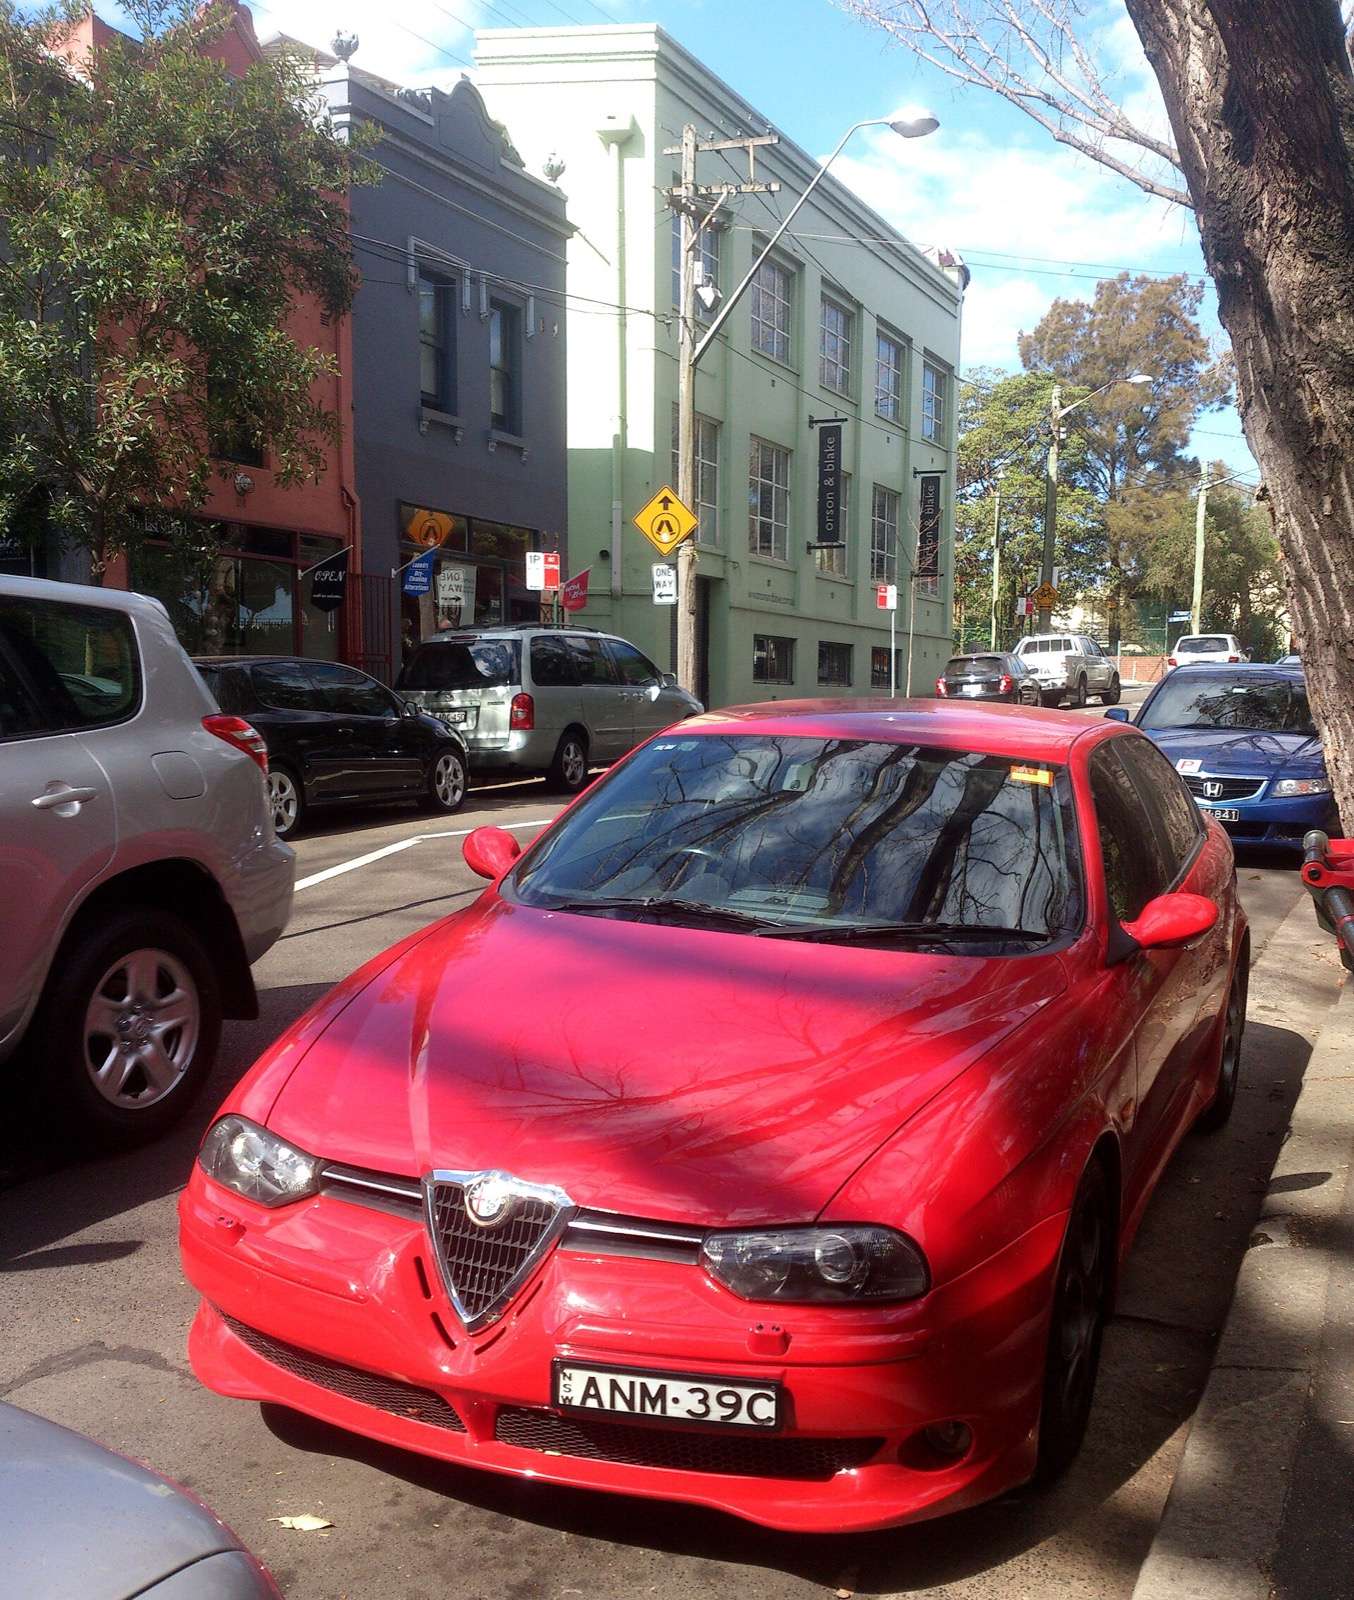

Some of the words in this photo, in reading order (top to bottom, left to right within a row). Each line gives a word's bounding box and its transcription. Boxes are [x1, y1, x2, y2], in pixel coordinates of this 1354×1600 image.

[824, 437, 835, 472] blake
[824, 476, 834, 487] &
[925, 485, 935, 514] blake
[825, 492, 834, 531] orson
[314, 570, 346, 581] OPEN
[656, 568, 672, 577] ONE
[655, 580, 673, 589] WAY
[1181, 760, 1194, 769] P
